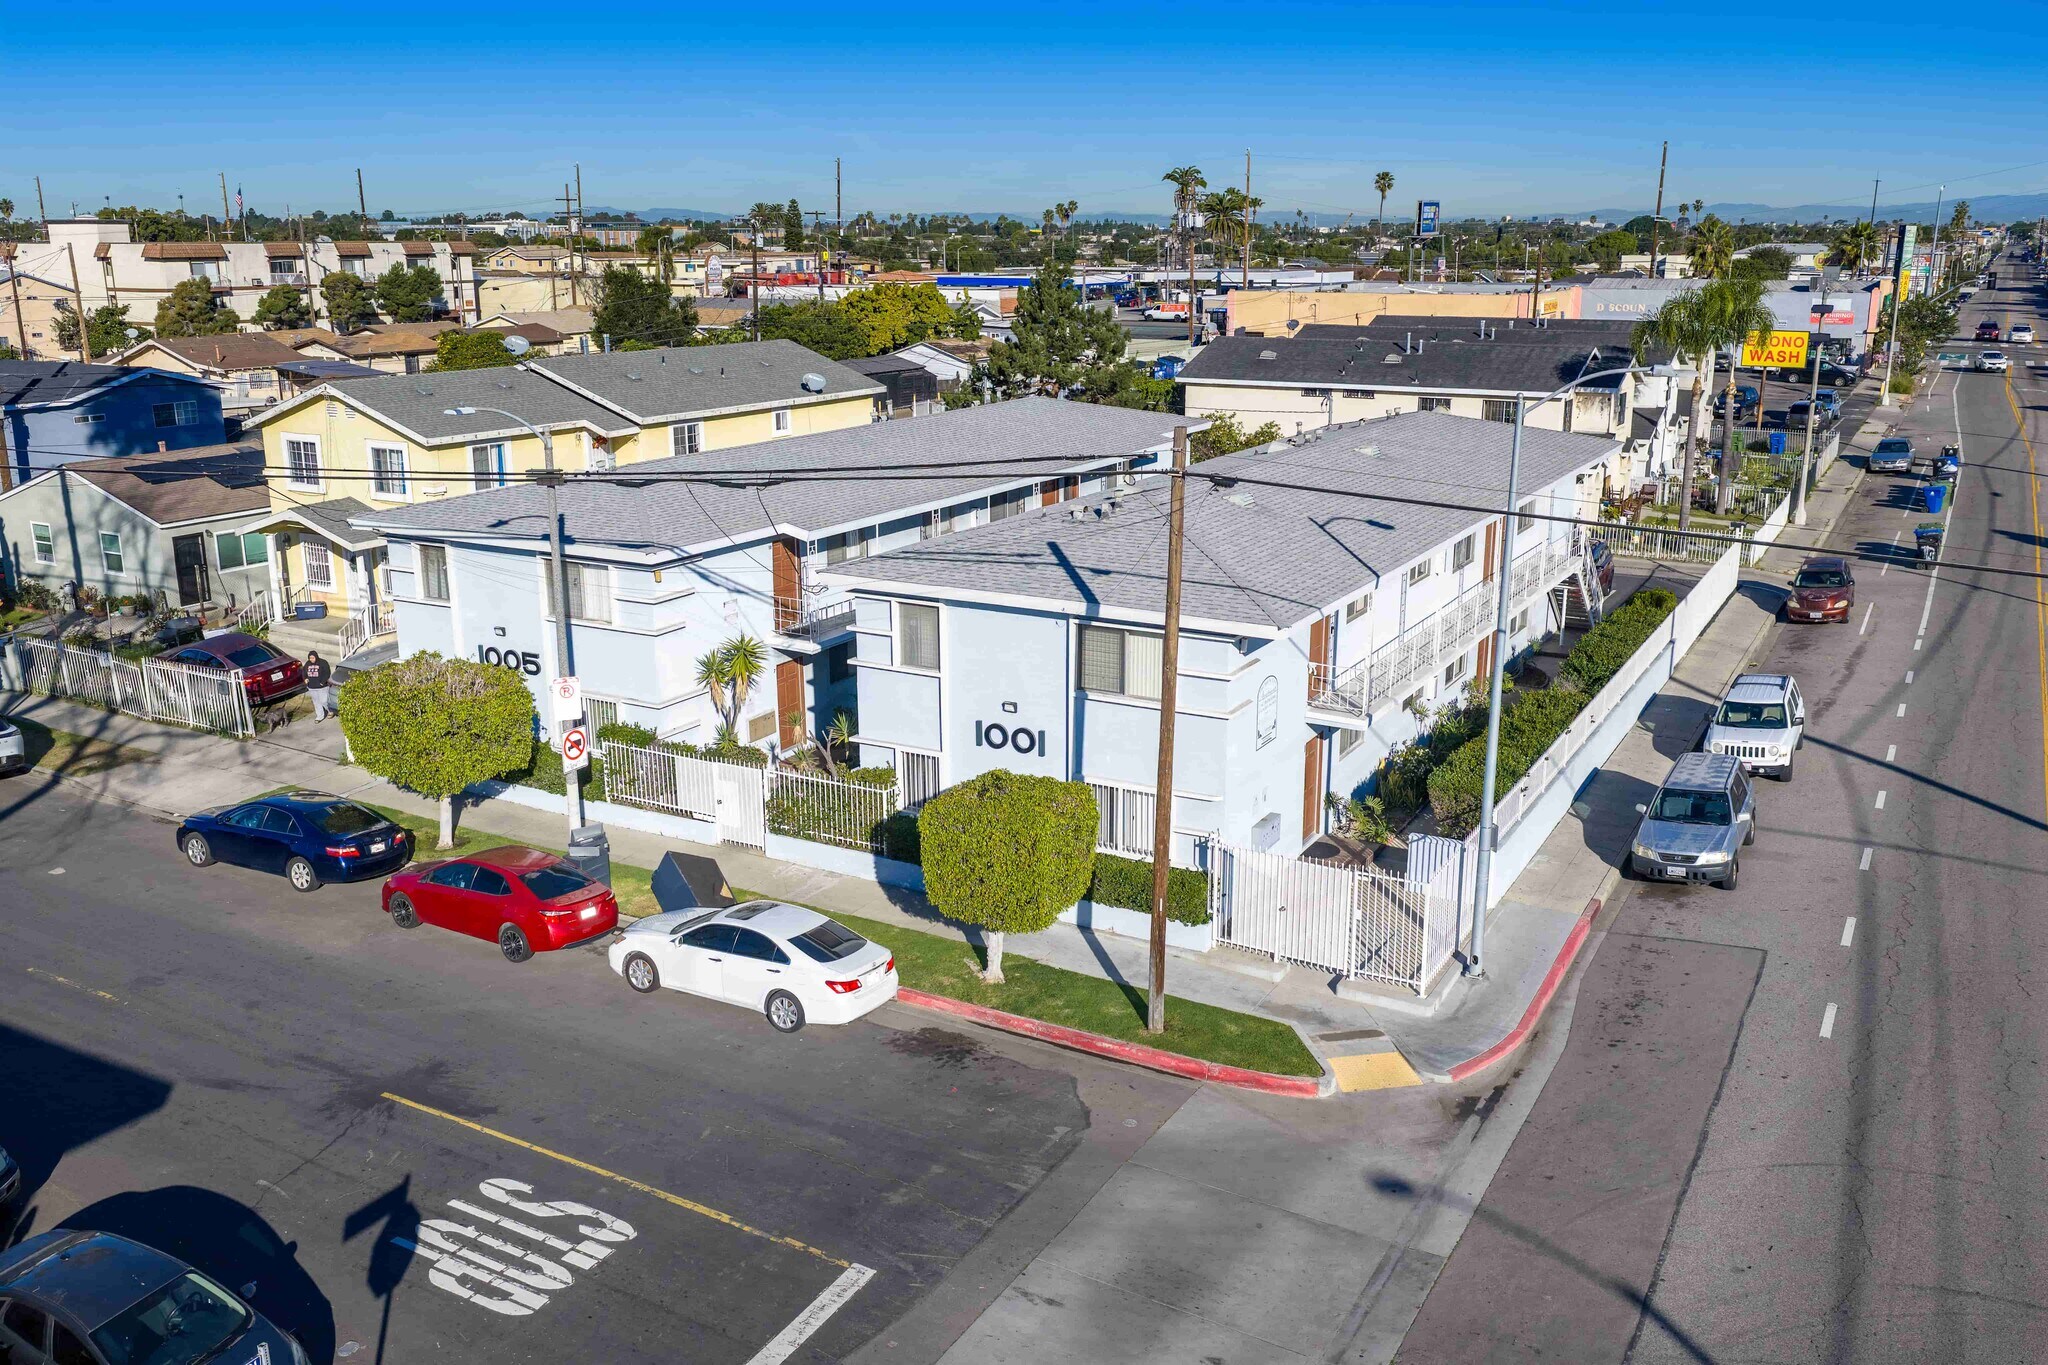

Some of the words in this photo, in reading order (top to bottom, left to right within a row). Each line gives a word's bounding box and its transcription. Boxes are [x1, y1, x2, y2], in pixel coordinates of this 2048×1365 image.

[1746, 335, 1805, 348] EONO
[1749, 349, 1800, 363] WASH
[478, 644, 542, 676] 1005
[975, 720, 1046, 757] 1001
